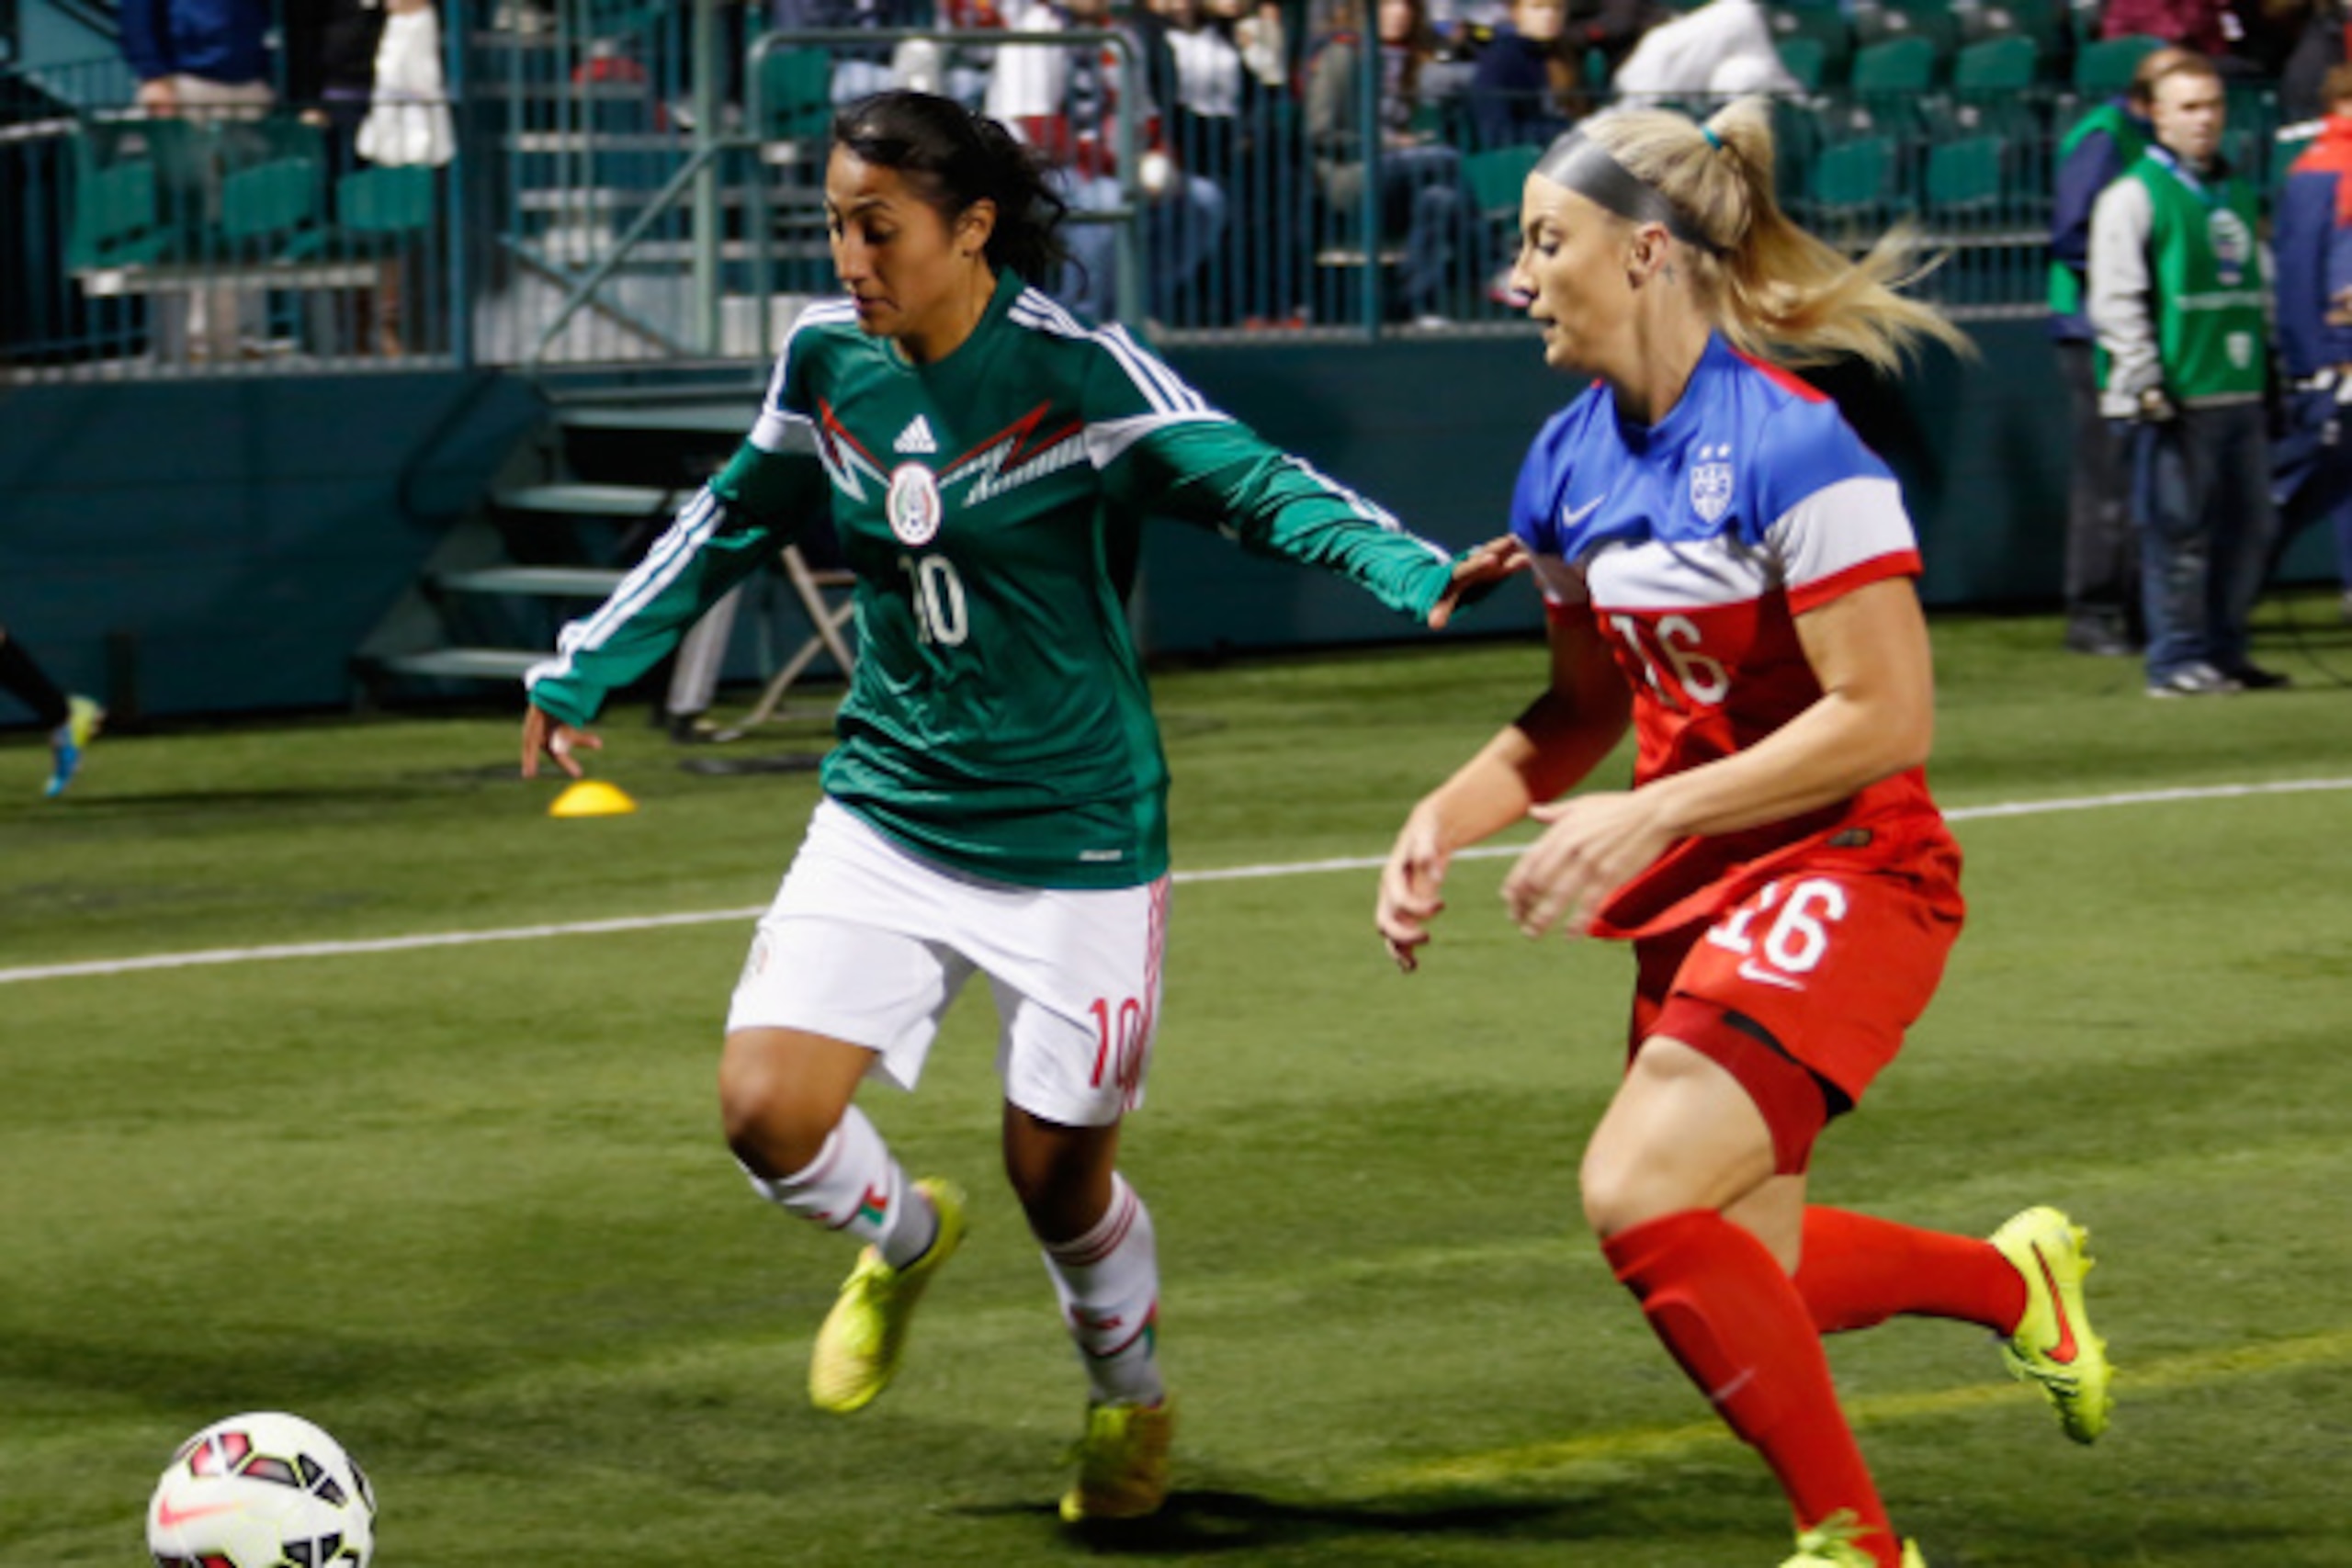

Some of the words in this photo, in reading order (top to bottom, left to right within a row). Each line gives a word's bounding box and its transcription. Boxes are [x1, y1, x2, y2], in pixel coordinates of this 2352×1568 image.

[898, 553, 968, 648] 10
[1610, 614, 1730, 709] 16
[1704, 876, 1849, 975] 16
[1088, 997, 1142, 1089] 10
